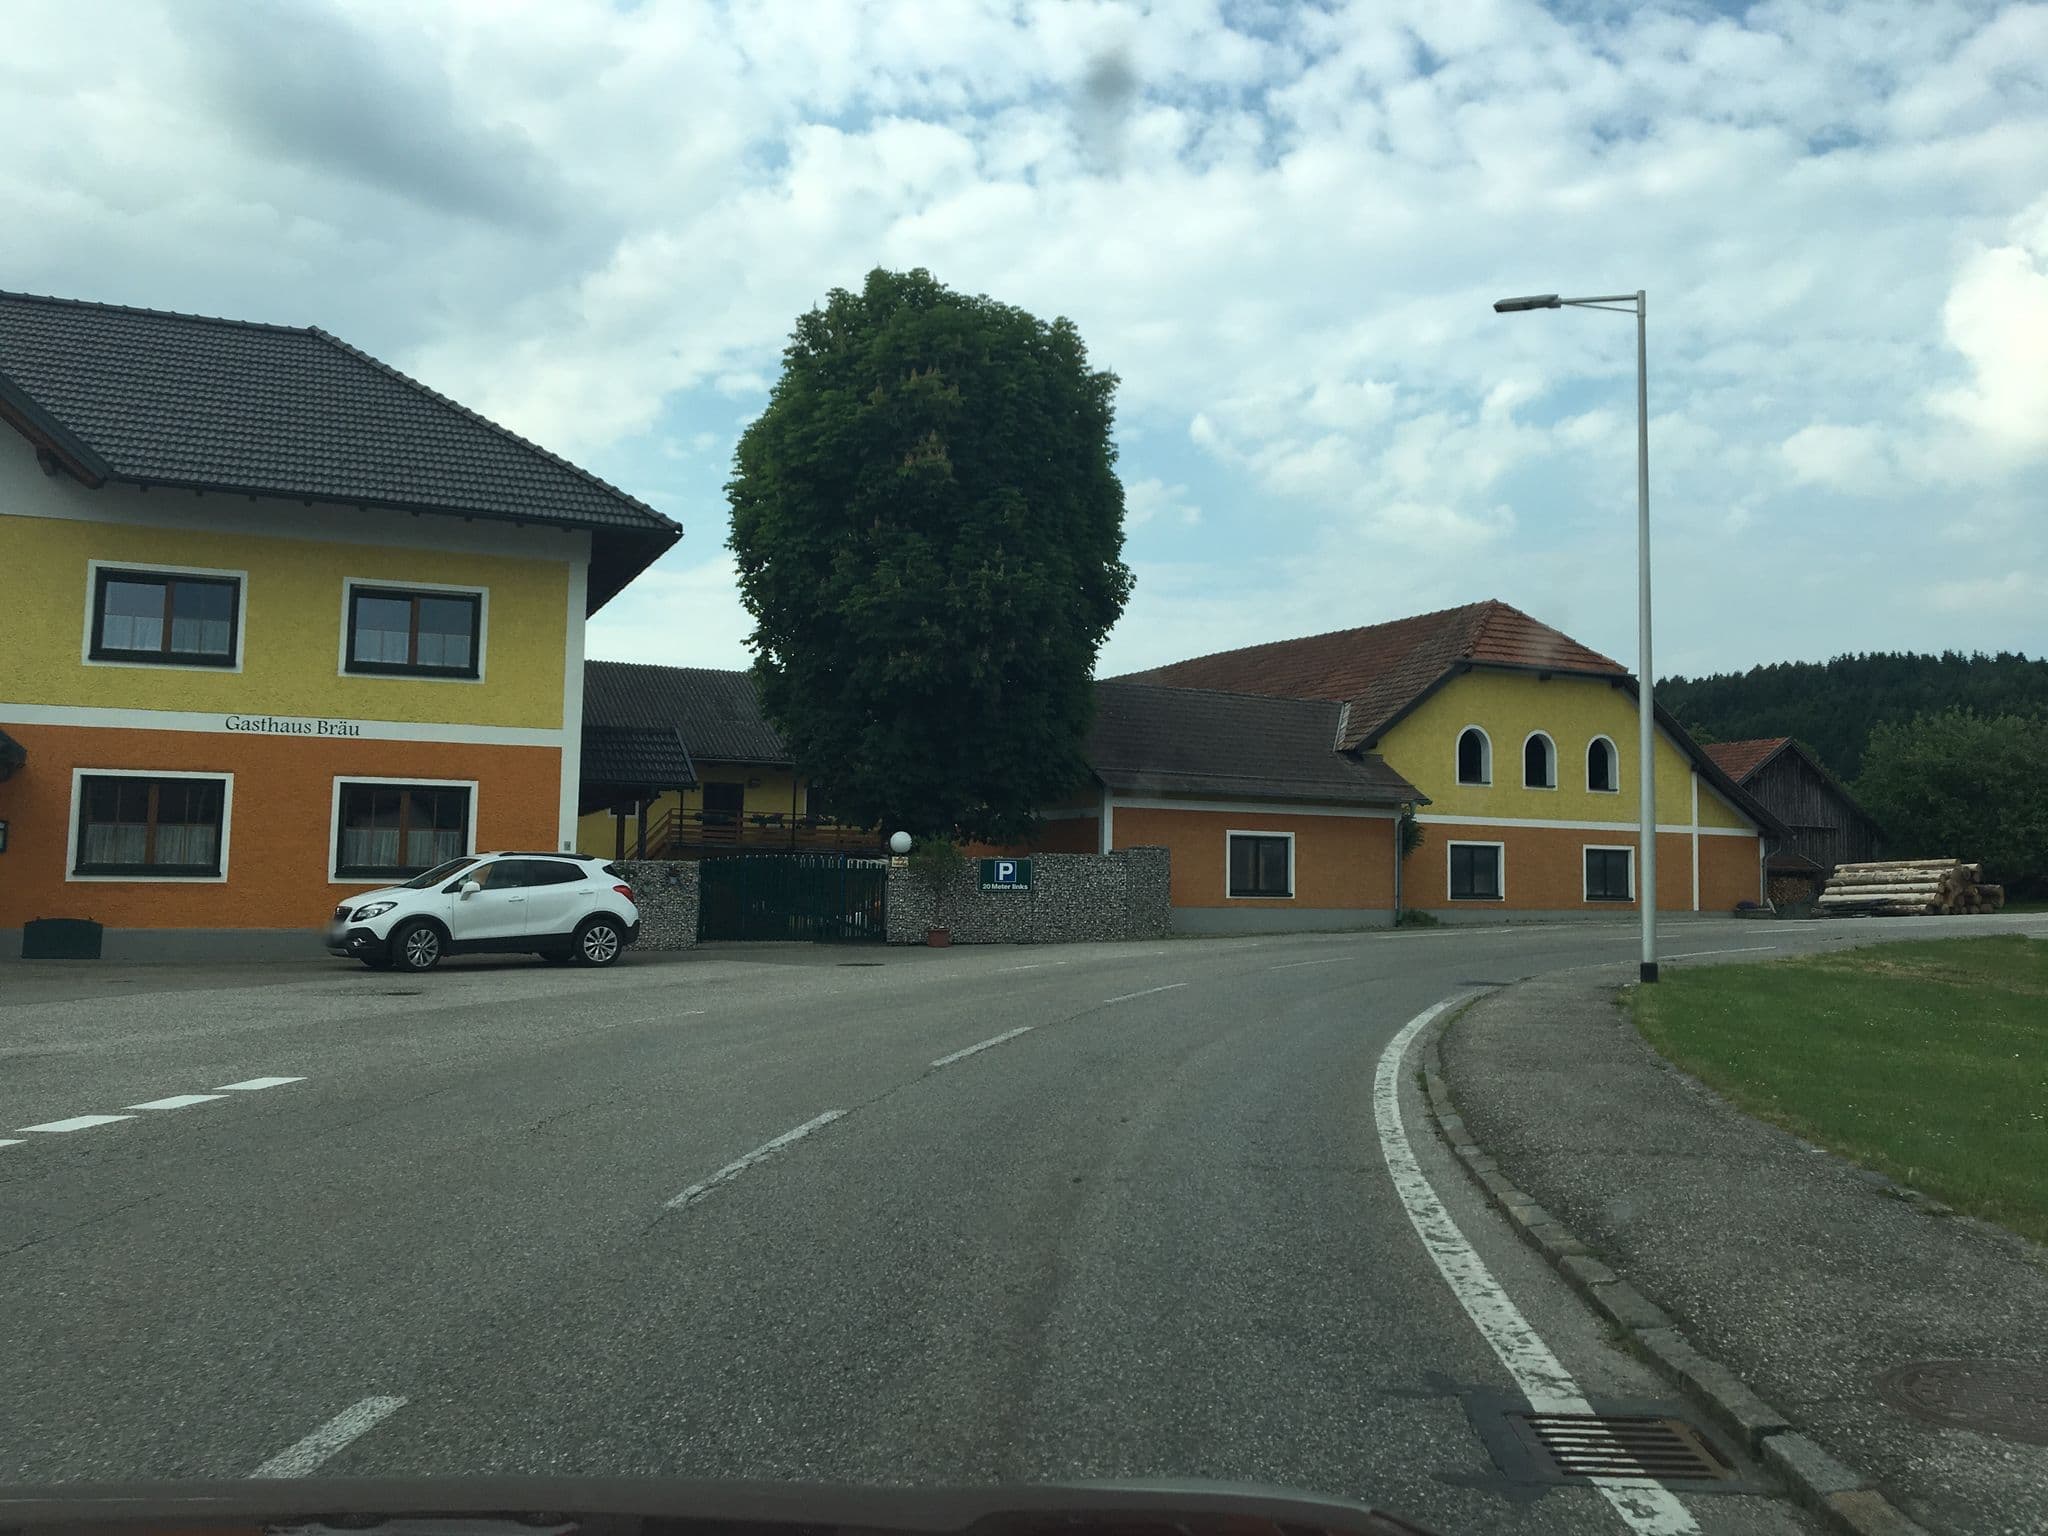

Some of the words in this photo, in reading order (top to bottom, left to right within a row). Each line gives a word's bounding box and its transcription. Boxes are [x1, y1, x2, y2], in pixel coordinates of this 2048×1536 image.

[225, 715, 312, 734] Gasthaus
[317, 720, 360, 736] Bräu
[999, 863, 1014, 880] P
